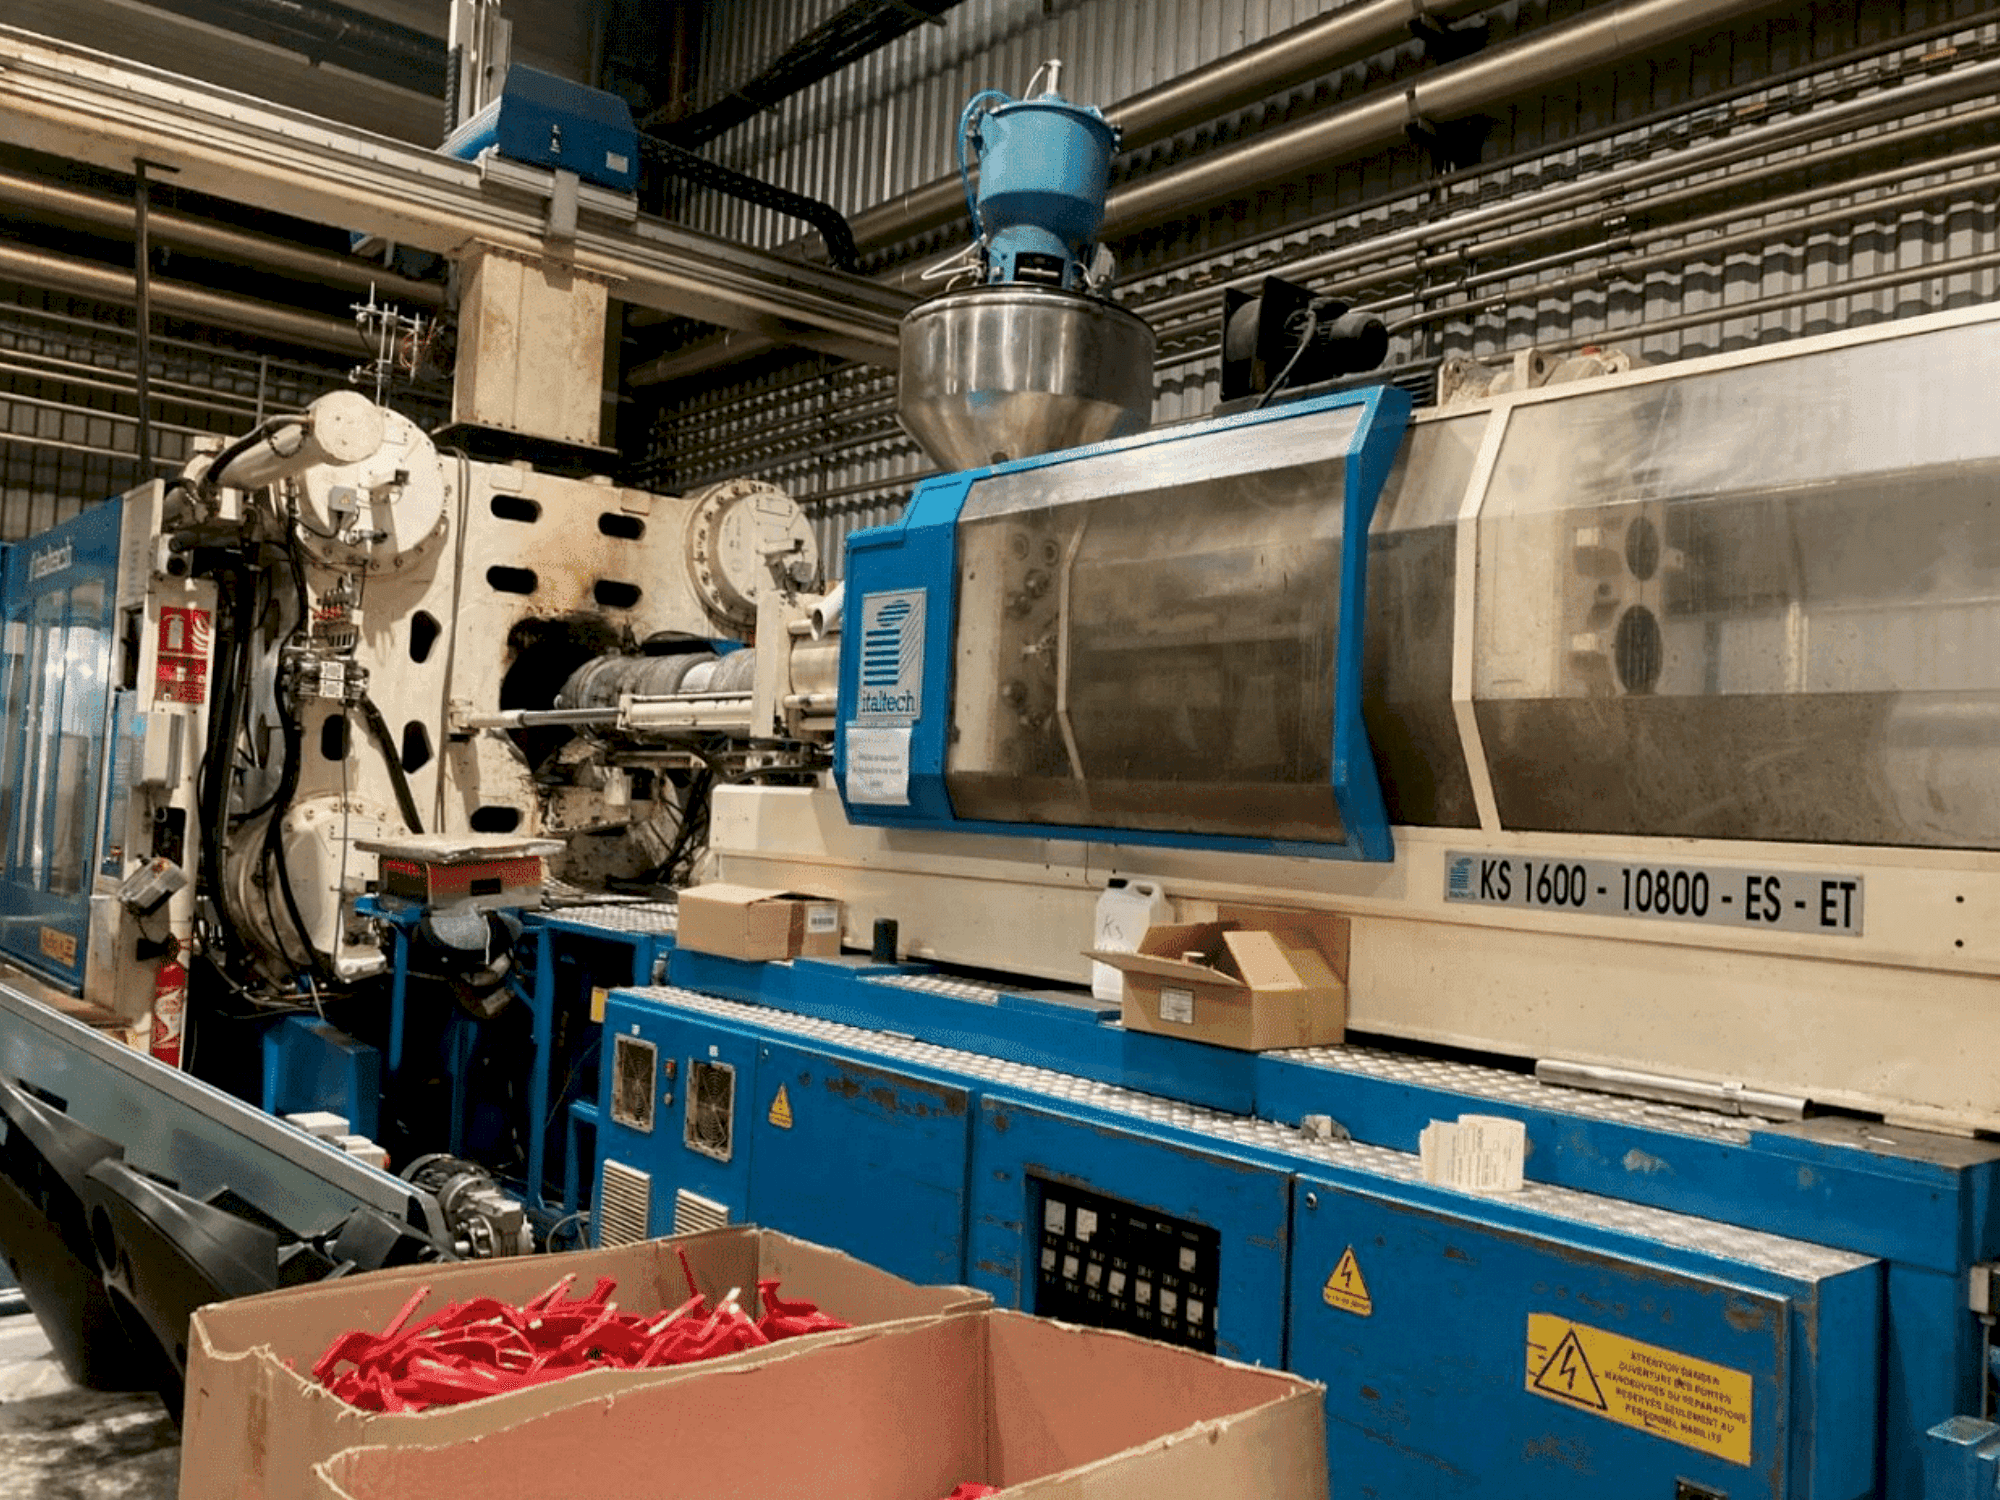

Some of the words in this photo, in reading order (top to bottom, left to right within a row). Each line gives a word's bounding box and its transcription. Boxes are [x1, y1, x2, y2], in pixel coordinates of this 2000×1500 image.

[861, 690, 916, 713] italtech
[1480, 860, 1513, 901] KS
[1524, 862, 1586, 907] 1600
[1621, 868, 1709, 917] 10800
[1745, 875, 1781, 922] ES
[1820, 880, 1857, 928] ET
[1630, 1350, 1679, 1374] ATTENTION
